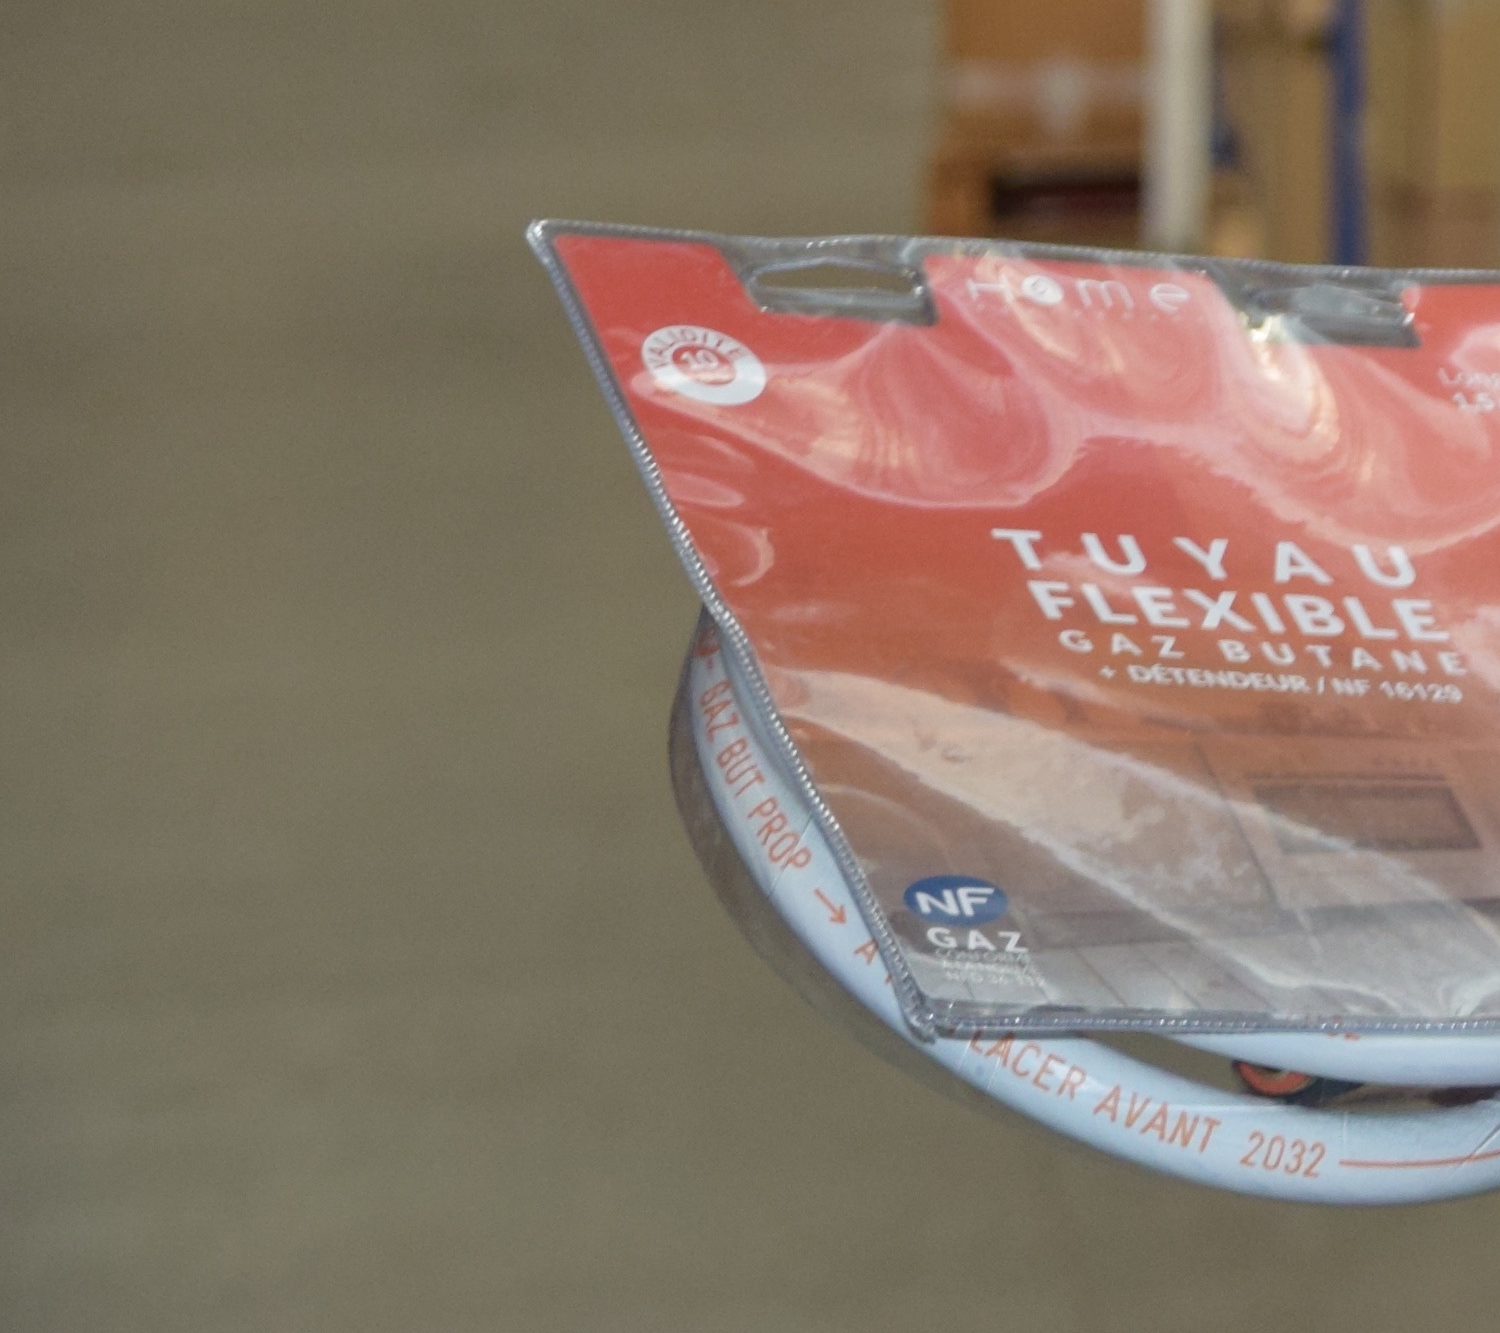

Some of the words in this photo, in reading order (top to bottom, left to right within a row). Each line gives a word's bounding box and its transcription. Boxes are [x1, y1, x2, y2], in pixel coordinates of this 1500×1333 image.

[992, 528, 1417, 588] TUYAU
[1027, 579, 1450, 641] FLEXIBLE
[1059, 629, 1185, 659] GAZ
[1218, 639, 1468, 677] BUTANE
[1126, 663, 1312, 694] DÉTENDEUR
[1317, 675, 1326, 695] /
[1331, 676, 1371, 697] NF
[699, 679, 741, 744] GAZ
[716, 736, 765, 798] BUT
[746, 795, 812, 872] PROP
[914, 886, 996, 917] NF
[926, 926, 1029, 954] GAZ
[1092, 1085, 1222, 1152] AVANT
[1239, 1130, 1327, 1178] 2032
